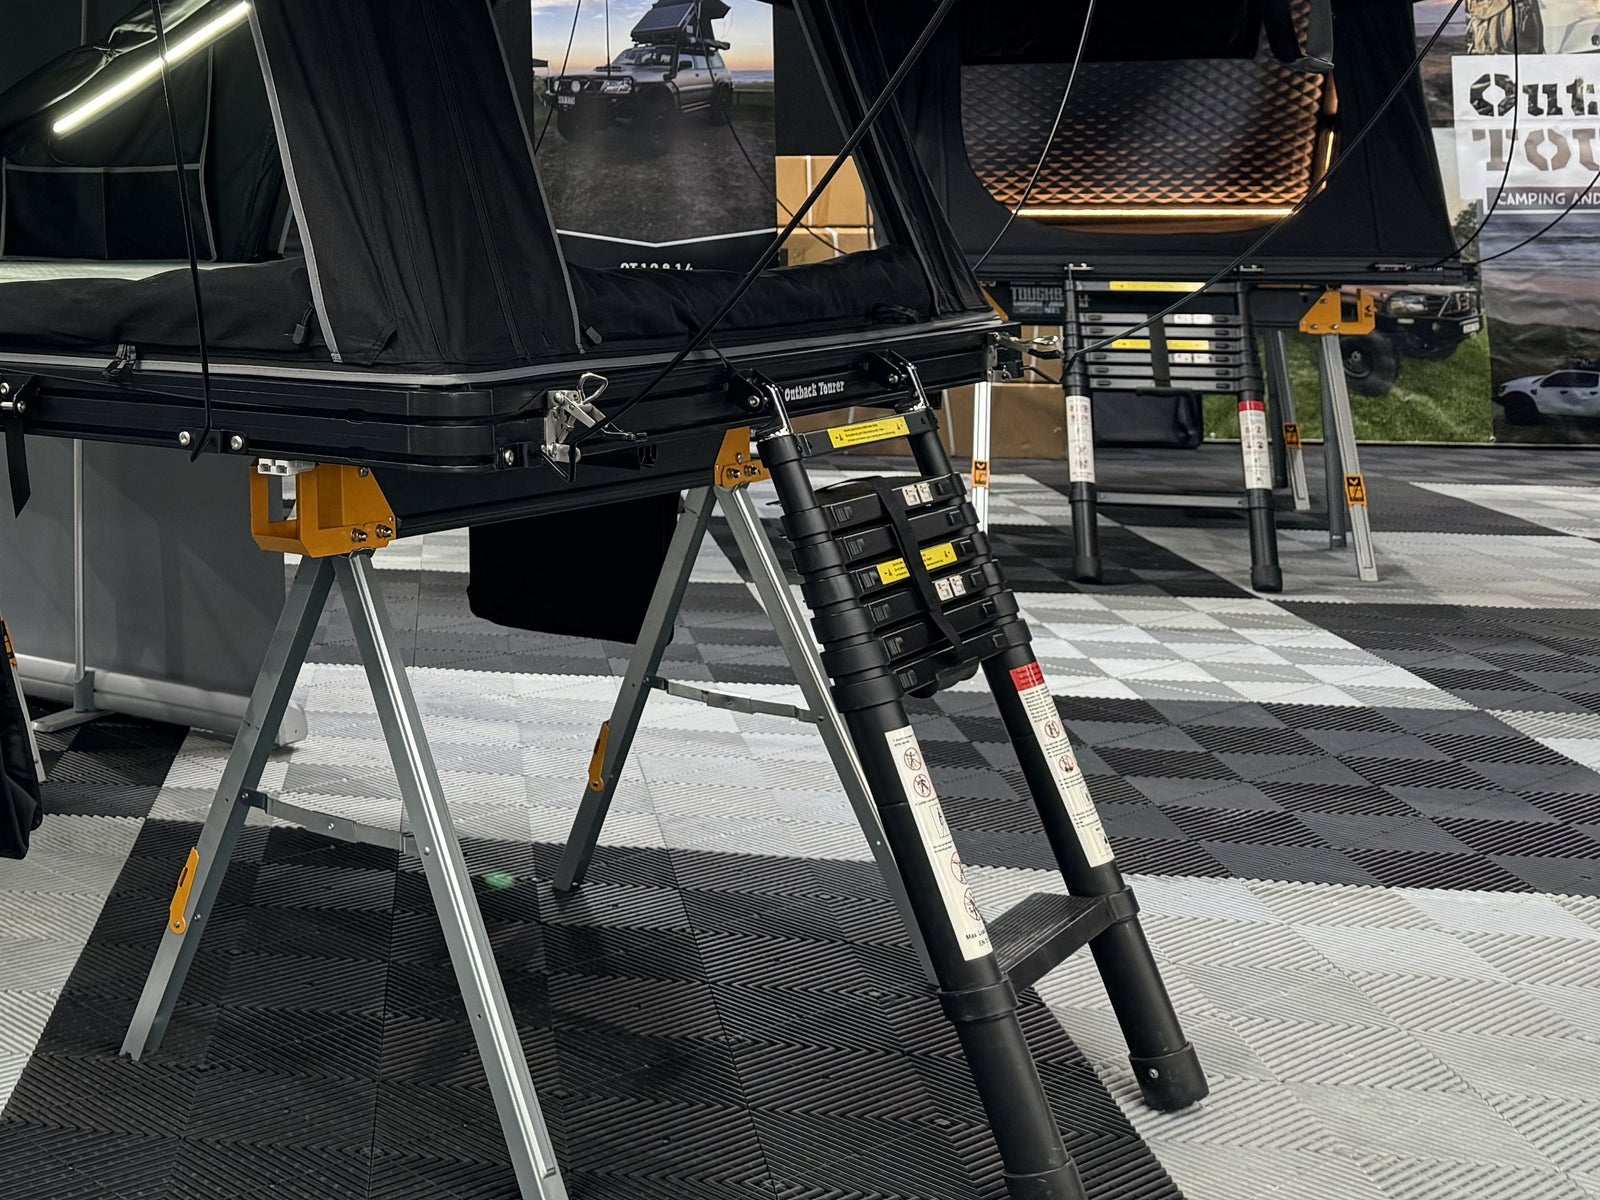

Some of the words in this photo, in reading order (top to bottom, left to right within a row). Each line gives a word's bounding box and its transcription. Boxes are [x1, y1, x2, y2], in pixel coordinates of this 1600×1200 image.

[1498, 191, 1566, 205] CAMPING
[784, 383, 818, 402] Outback
[818, 380, 845, 396] Tourer
